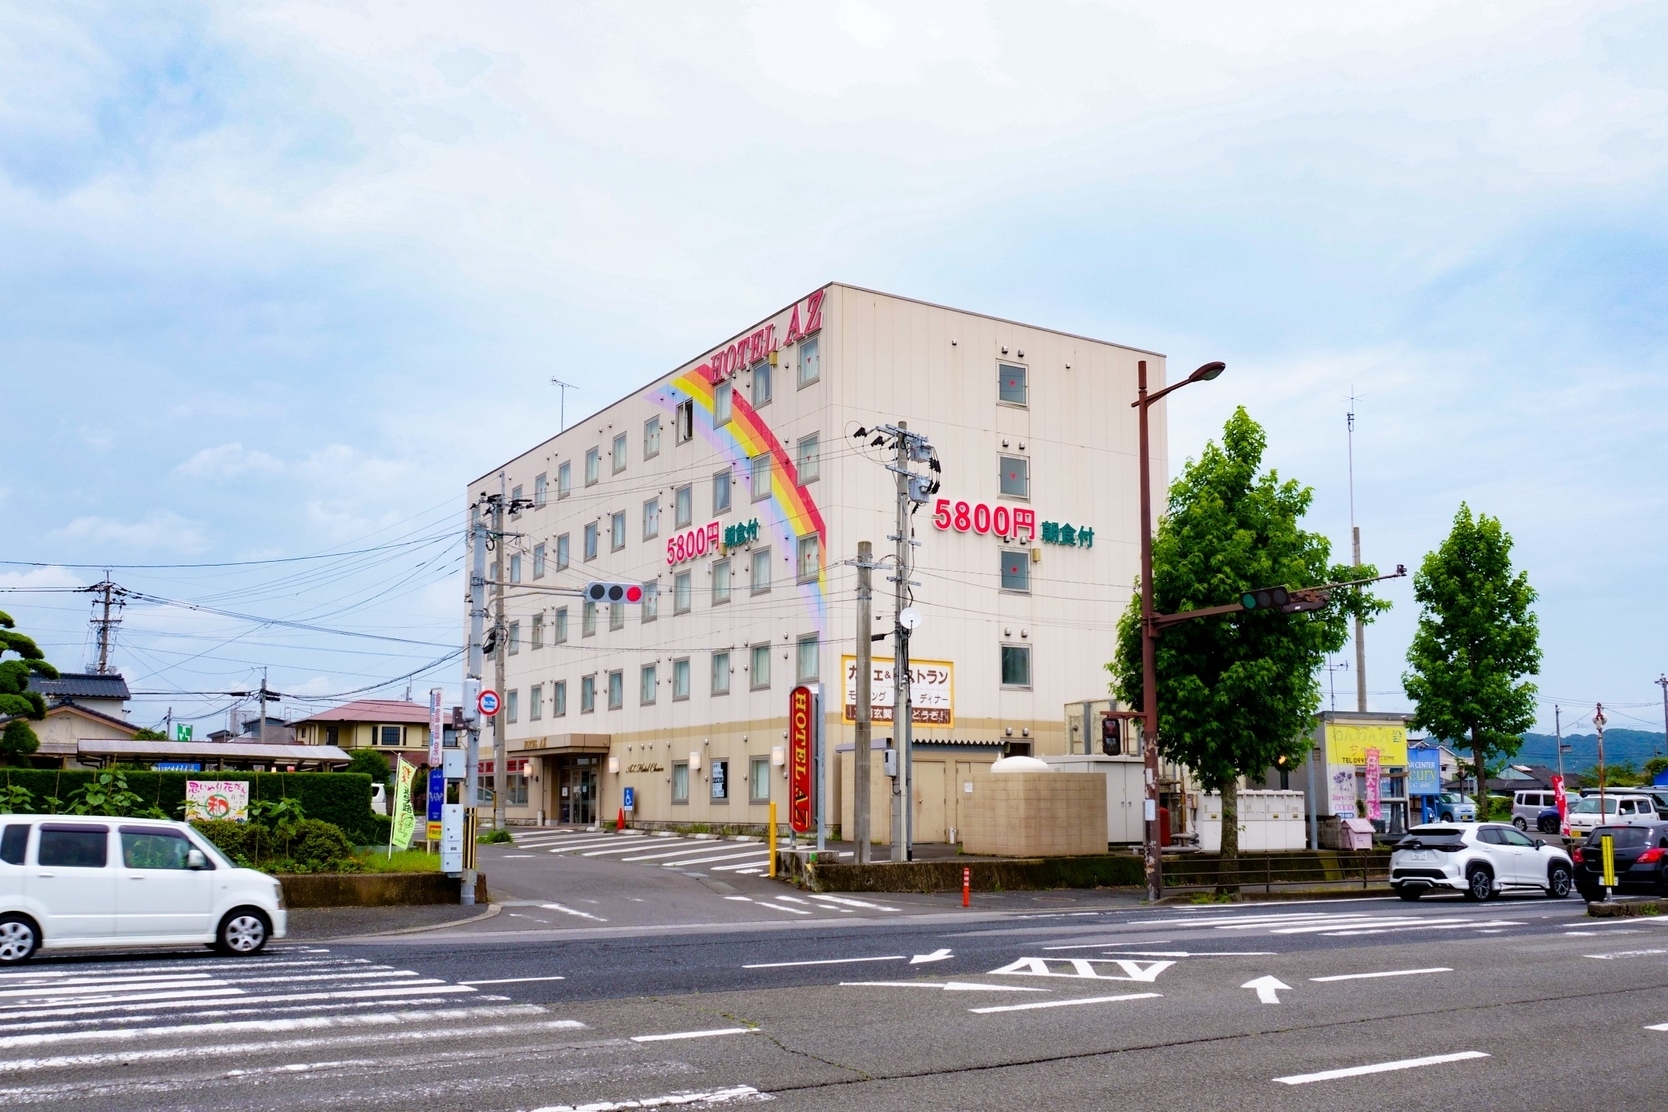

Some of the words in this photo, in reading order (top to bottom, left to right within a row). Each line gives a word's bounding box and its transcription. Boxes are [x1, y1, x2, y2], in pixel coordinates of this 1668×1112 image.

[709, 323, 778, 385] HOTEL
[783, 289, 826, 346] AZ
[666, 520, 722, 566] 5800円
[724, 518, 760, 549] 朝食付
[932, 498, 1037, 542] 5800円
[1040, 520, 1095, 549] 朝食付
[848, 690, 887, 702] モング
[919, 693, 948, 704] ディナー
[524, 740, 538, 750] HOTEL
[795, 691, 807, 780] HOTEL
[207, 795, 229, 816] 和
[795, 782, 808, 828] AZ
